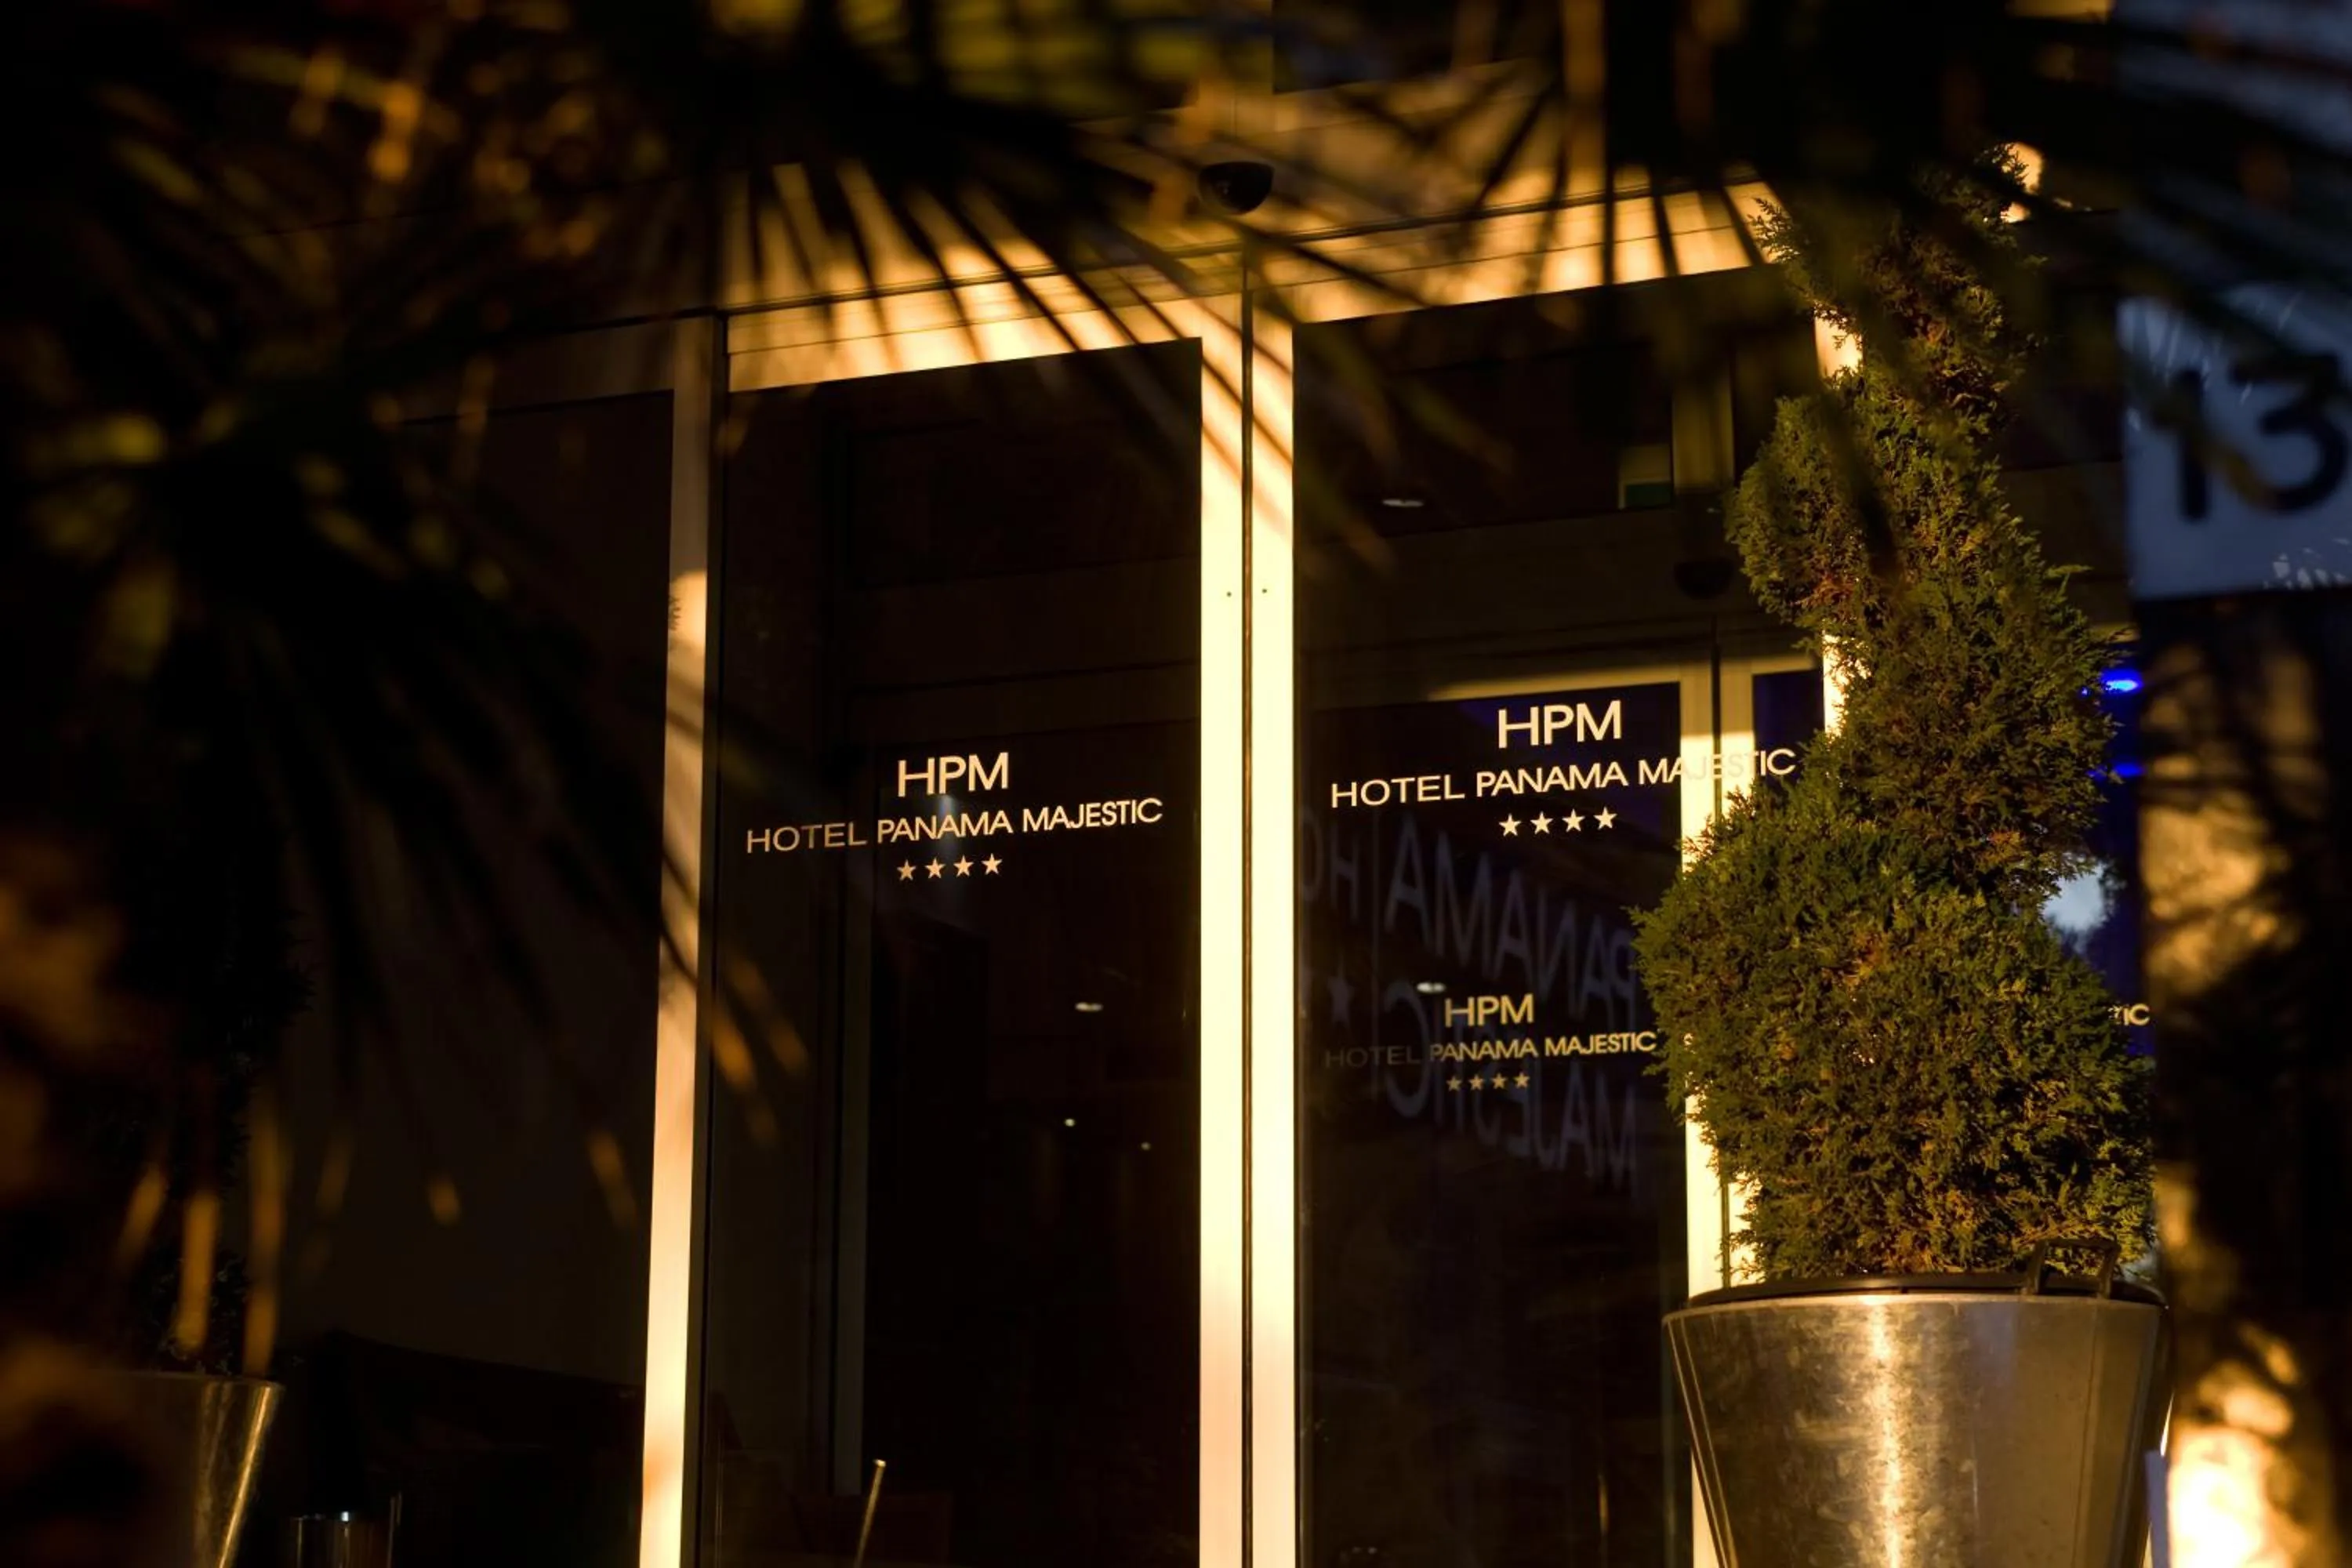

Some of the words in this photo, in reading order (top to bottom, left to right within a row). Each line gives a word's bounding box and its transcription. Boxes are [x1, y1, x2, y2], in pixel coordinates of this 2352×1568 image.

[2152, 349, 2347, 520] 13
[1496, 699, 1623, 750] HPM
[896, 752, 1011, 797] HPM
[1330, 775, 1465, 808] HOTEL
[1475, 760, 1629, 798] PANAMA
[1638, 748, 1796, 785] MAJESTIC
[746, 821, 867, 854] HOTEL
[876, 810, 1014, 844] PANAMA
[1022, 797, 1163, 833] MAJESTIC
[1444, 993, 1534, 1028] HPM
[1325, 1044, 1421, 1069] HOTEL
[1429, 1037, 1539, 1063] PANAMA
[1544, 1030, 1658, 1058] MAJESTIC
